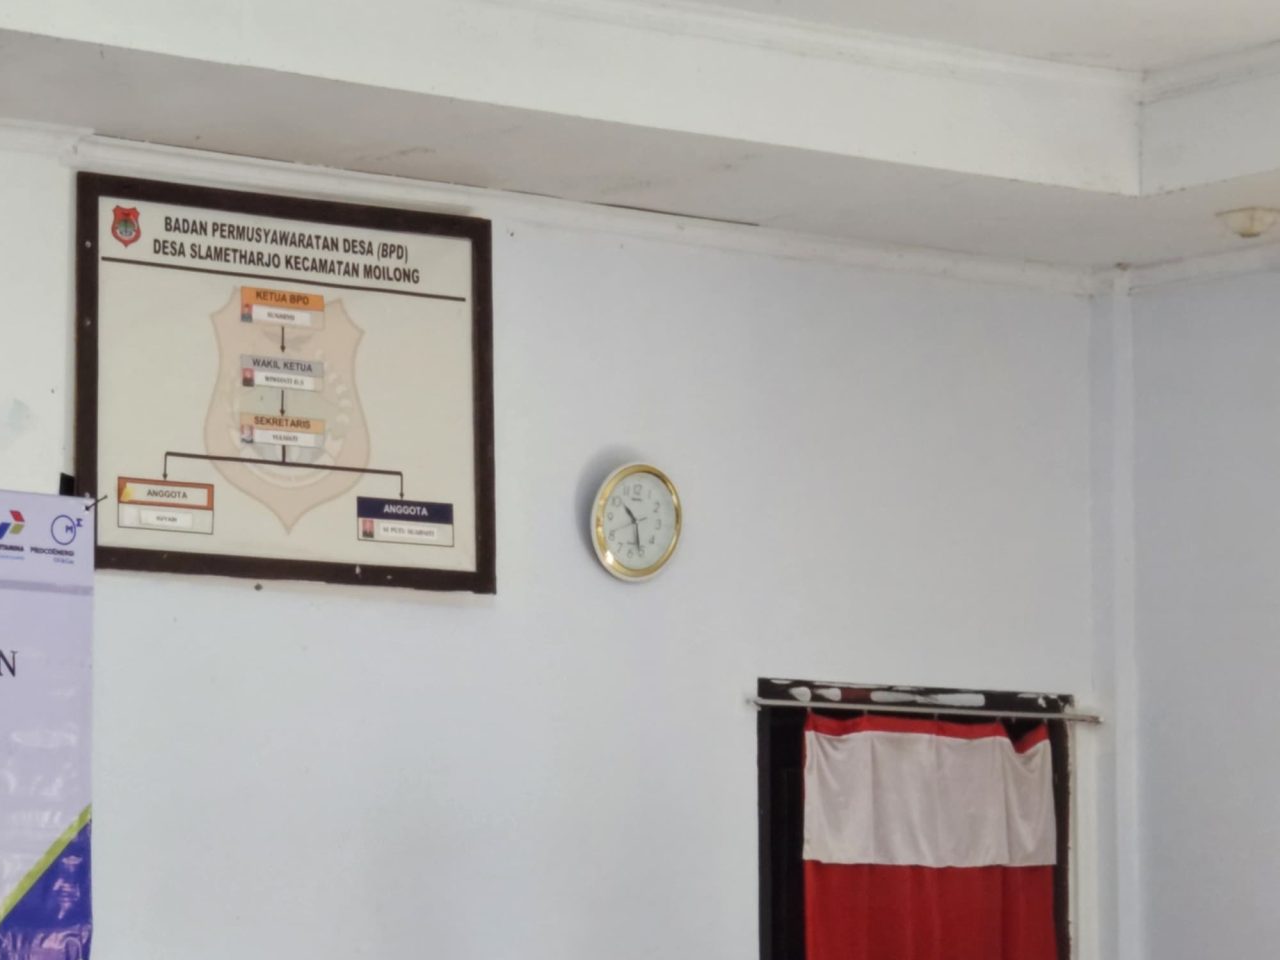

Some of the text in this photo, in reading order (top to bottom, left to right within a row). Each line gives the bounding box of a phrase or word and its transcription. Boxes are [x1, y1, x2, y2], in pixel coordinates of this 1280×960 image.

[164, 216, 409, 264] BADAN PERMUSYAWARATAN DESA (BPD)
[153, 239, 420, 284] DESA SLAMETHARJO KECAMATAN MOILONG
[255, 290, 287, 303] KETUA
[252, 358, 312, 373] WAKIL KETUA
[254, 416, 311, 430] SEKRETARIS
[146, 489, 188, 499] ANGGOTA
[383, 504, 429, 516] ANGGOTA
